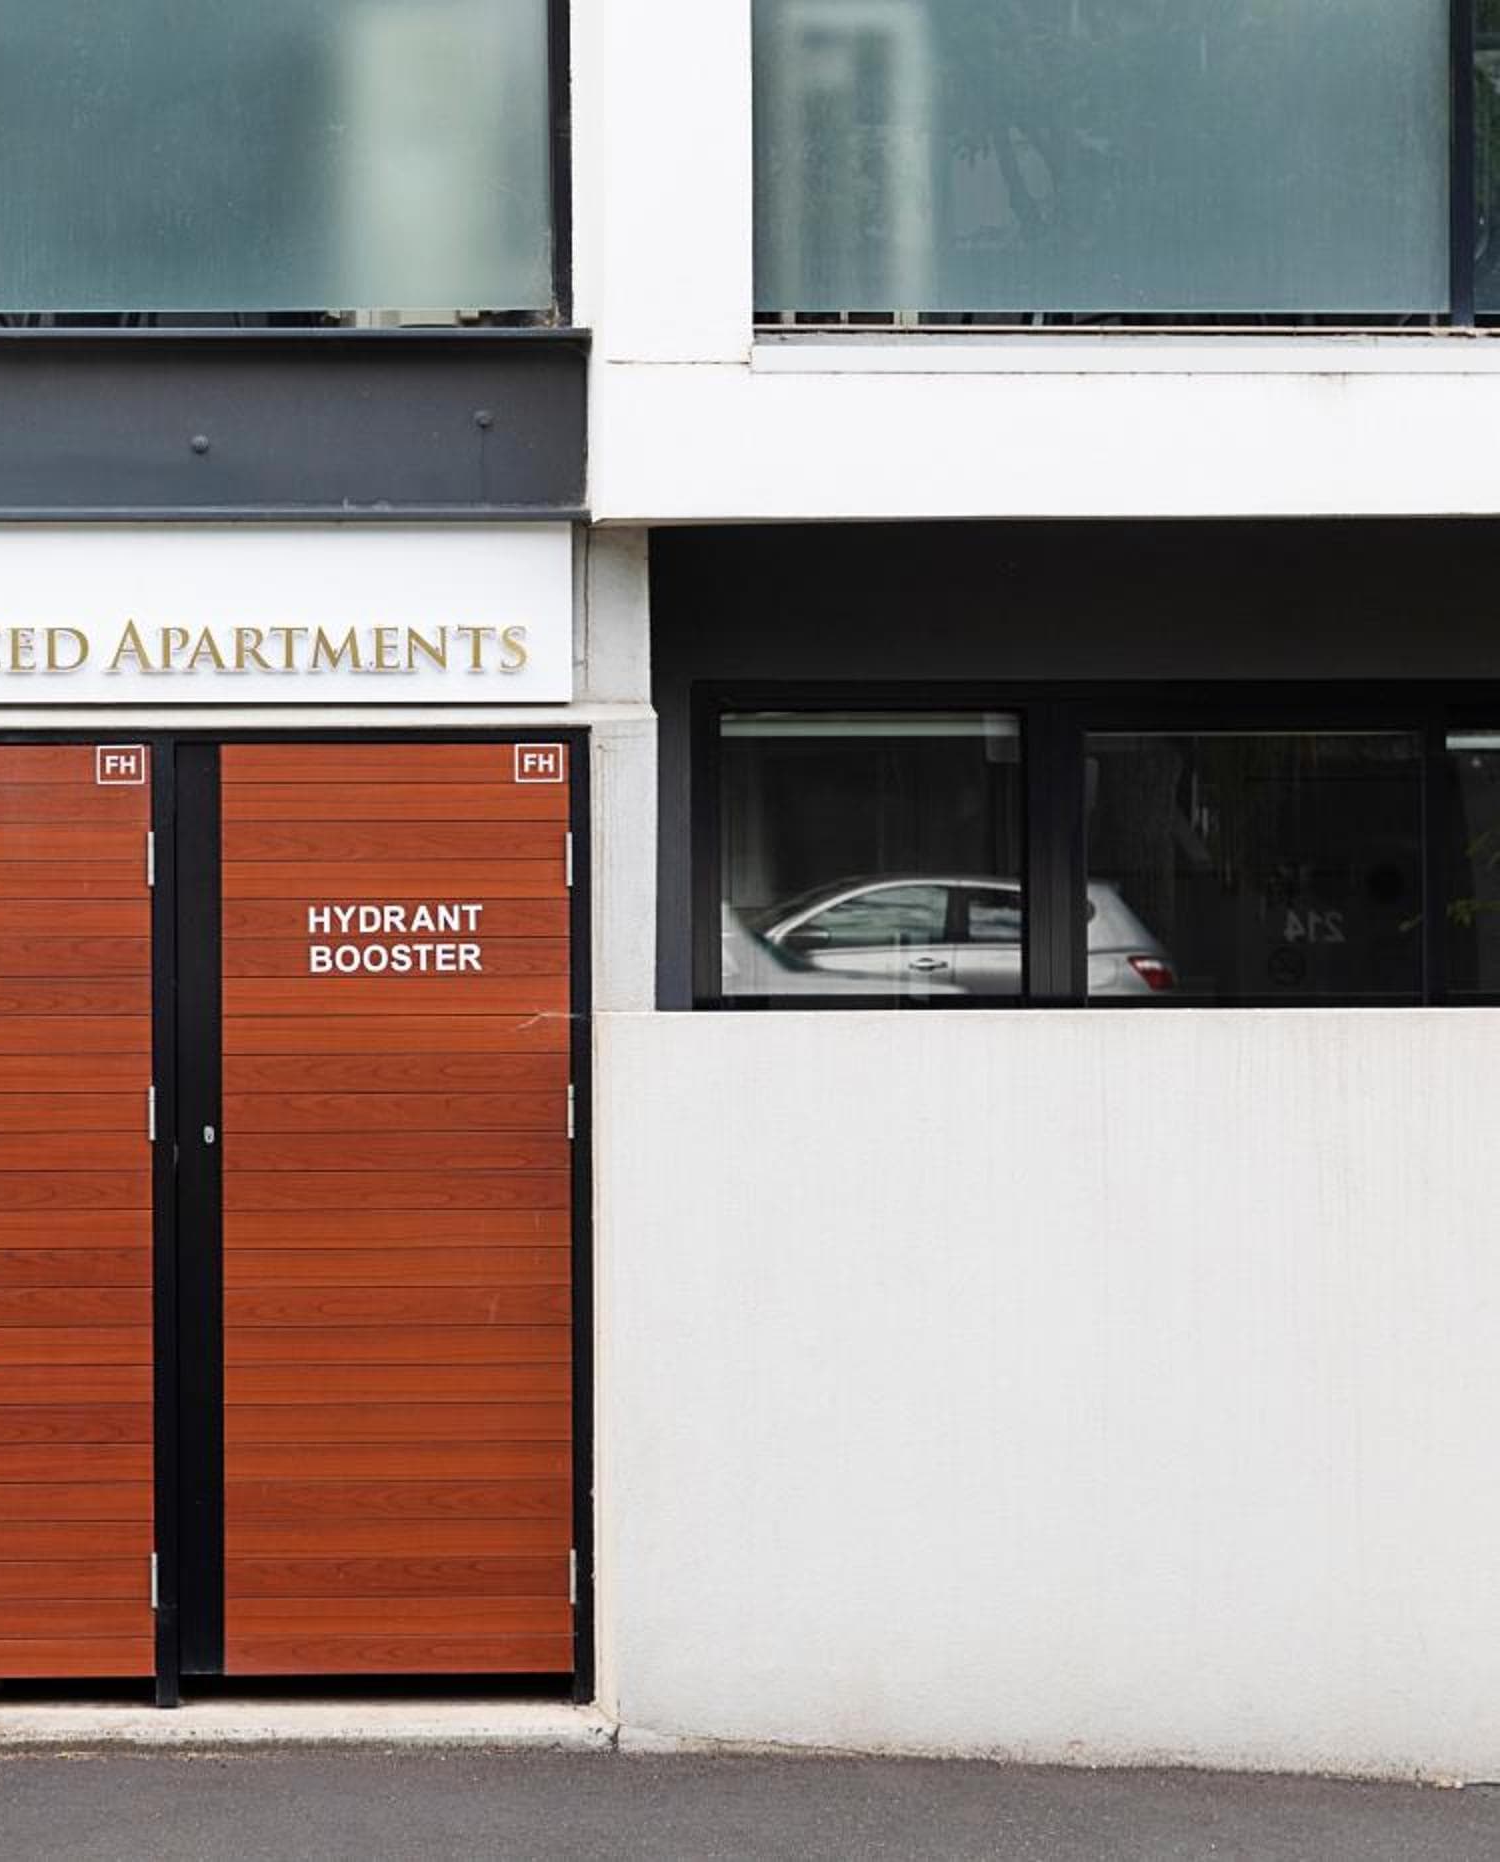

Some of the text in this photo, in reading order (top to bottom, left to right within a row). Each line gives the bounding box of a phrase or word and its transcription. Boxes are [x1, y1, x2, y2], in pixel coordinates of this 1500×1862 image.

[105, 754, 137, 775] FH
[523, 753, 555, 773] FH
[307, 904, 484, 934] HYDRANT
[308, 943, 484, 973] BOOSTER
